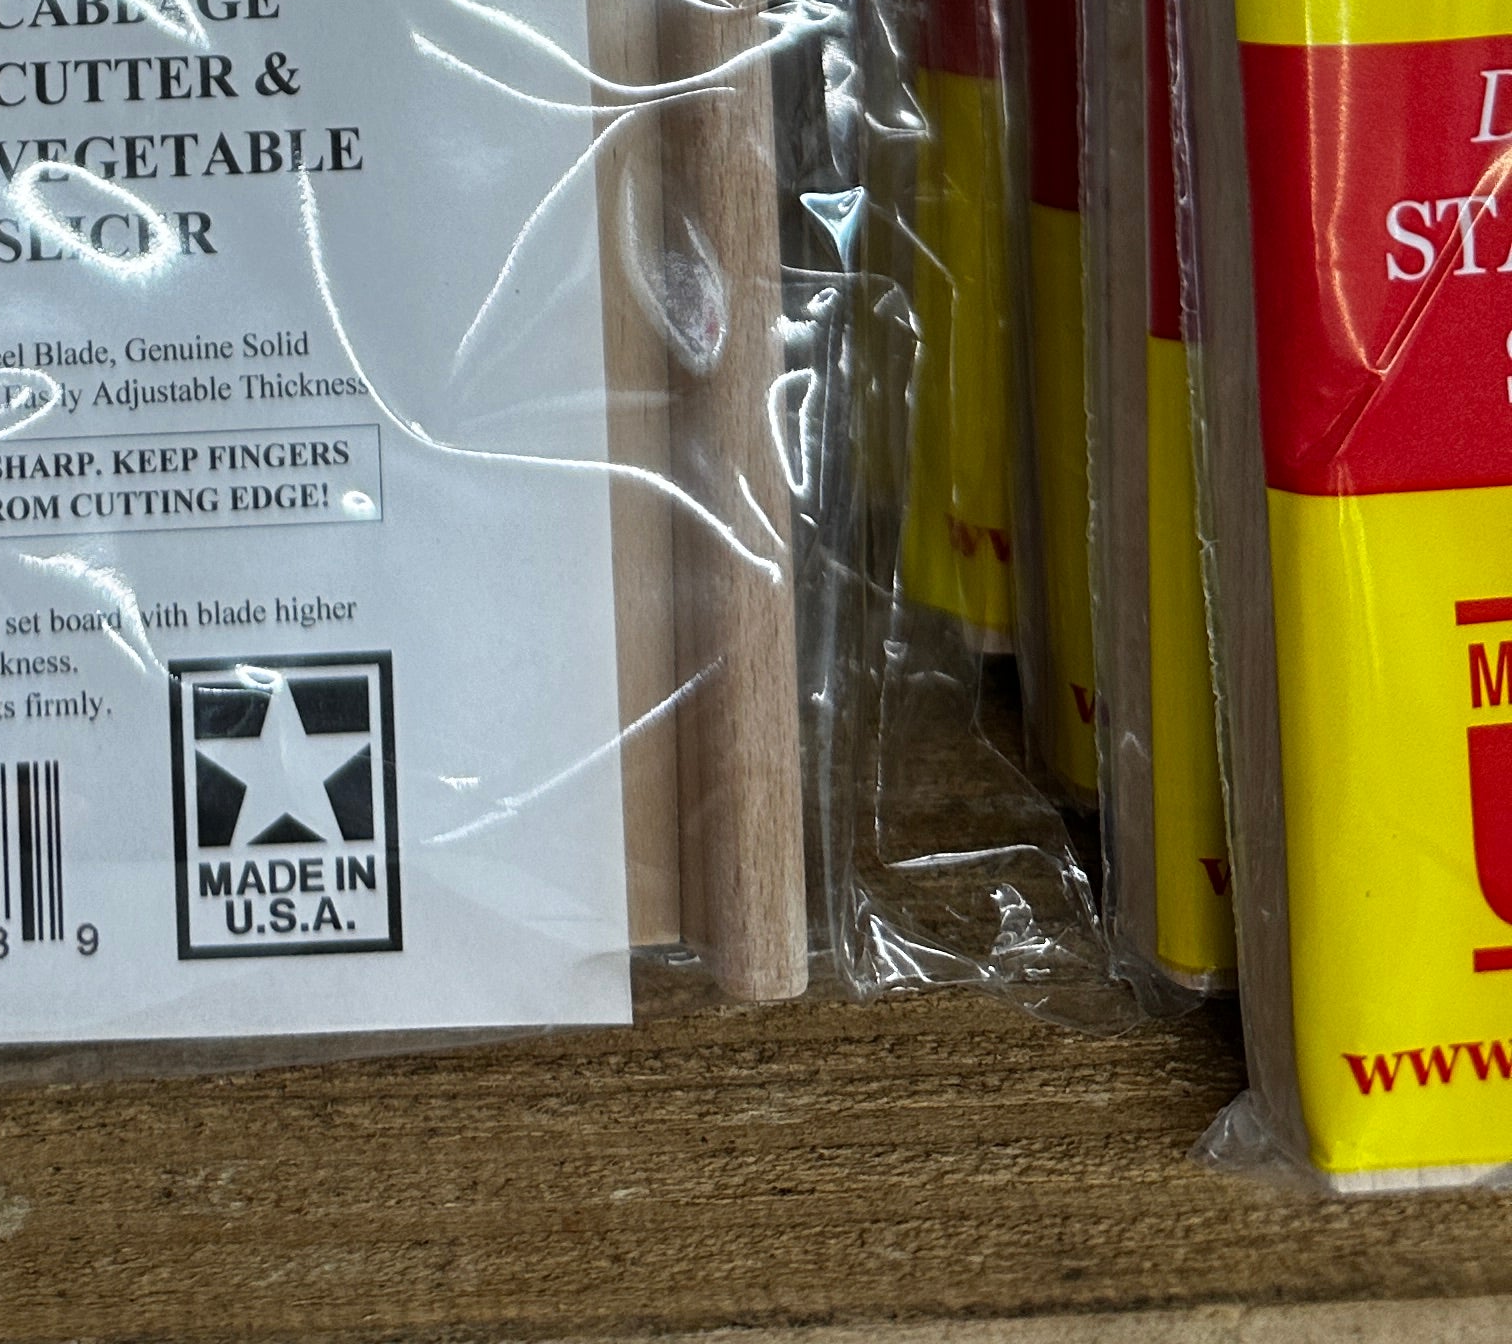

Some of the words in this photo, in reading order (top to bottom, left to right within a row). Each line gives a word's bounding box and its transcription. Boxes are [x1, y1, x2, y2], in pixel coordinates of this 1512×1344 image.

[255, 51, 301, 96] &
[1386, 195, 1512, 282] ST
[34, 338, 117, 370] Blade,
[124, 334, 234, 363] Genuine
[242, 330, 310, 359] Solid
[91, 373, 232, 411] Adjustable
[239, 370, 370, 403] Thickness
[112, 446, 199, 476] KEEP
[208, 440, 350, 471] FINGERS
[70, 487, 219, 519] CUTTING
[230, 482, 330, 512] EDGE!
[5, 610, 42, 635] set
[50, 606, 122, 633] board
[197, 598, 267, 626] blade
[275, 595, 358, 629] higher
[25, 690, 113, 721] firmly.
[198, 857, 326, 898] MADE
[335, 854, 377, 891] IN
[225, 895, 357, 934] U.S.A.
[76, 922, 100, 957] 9
